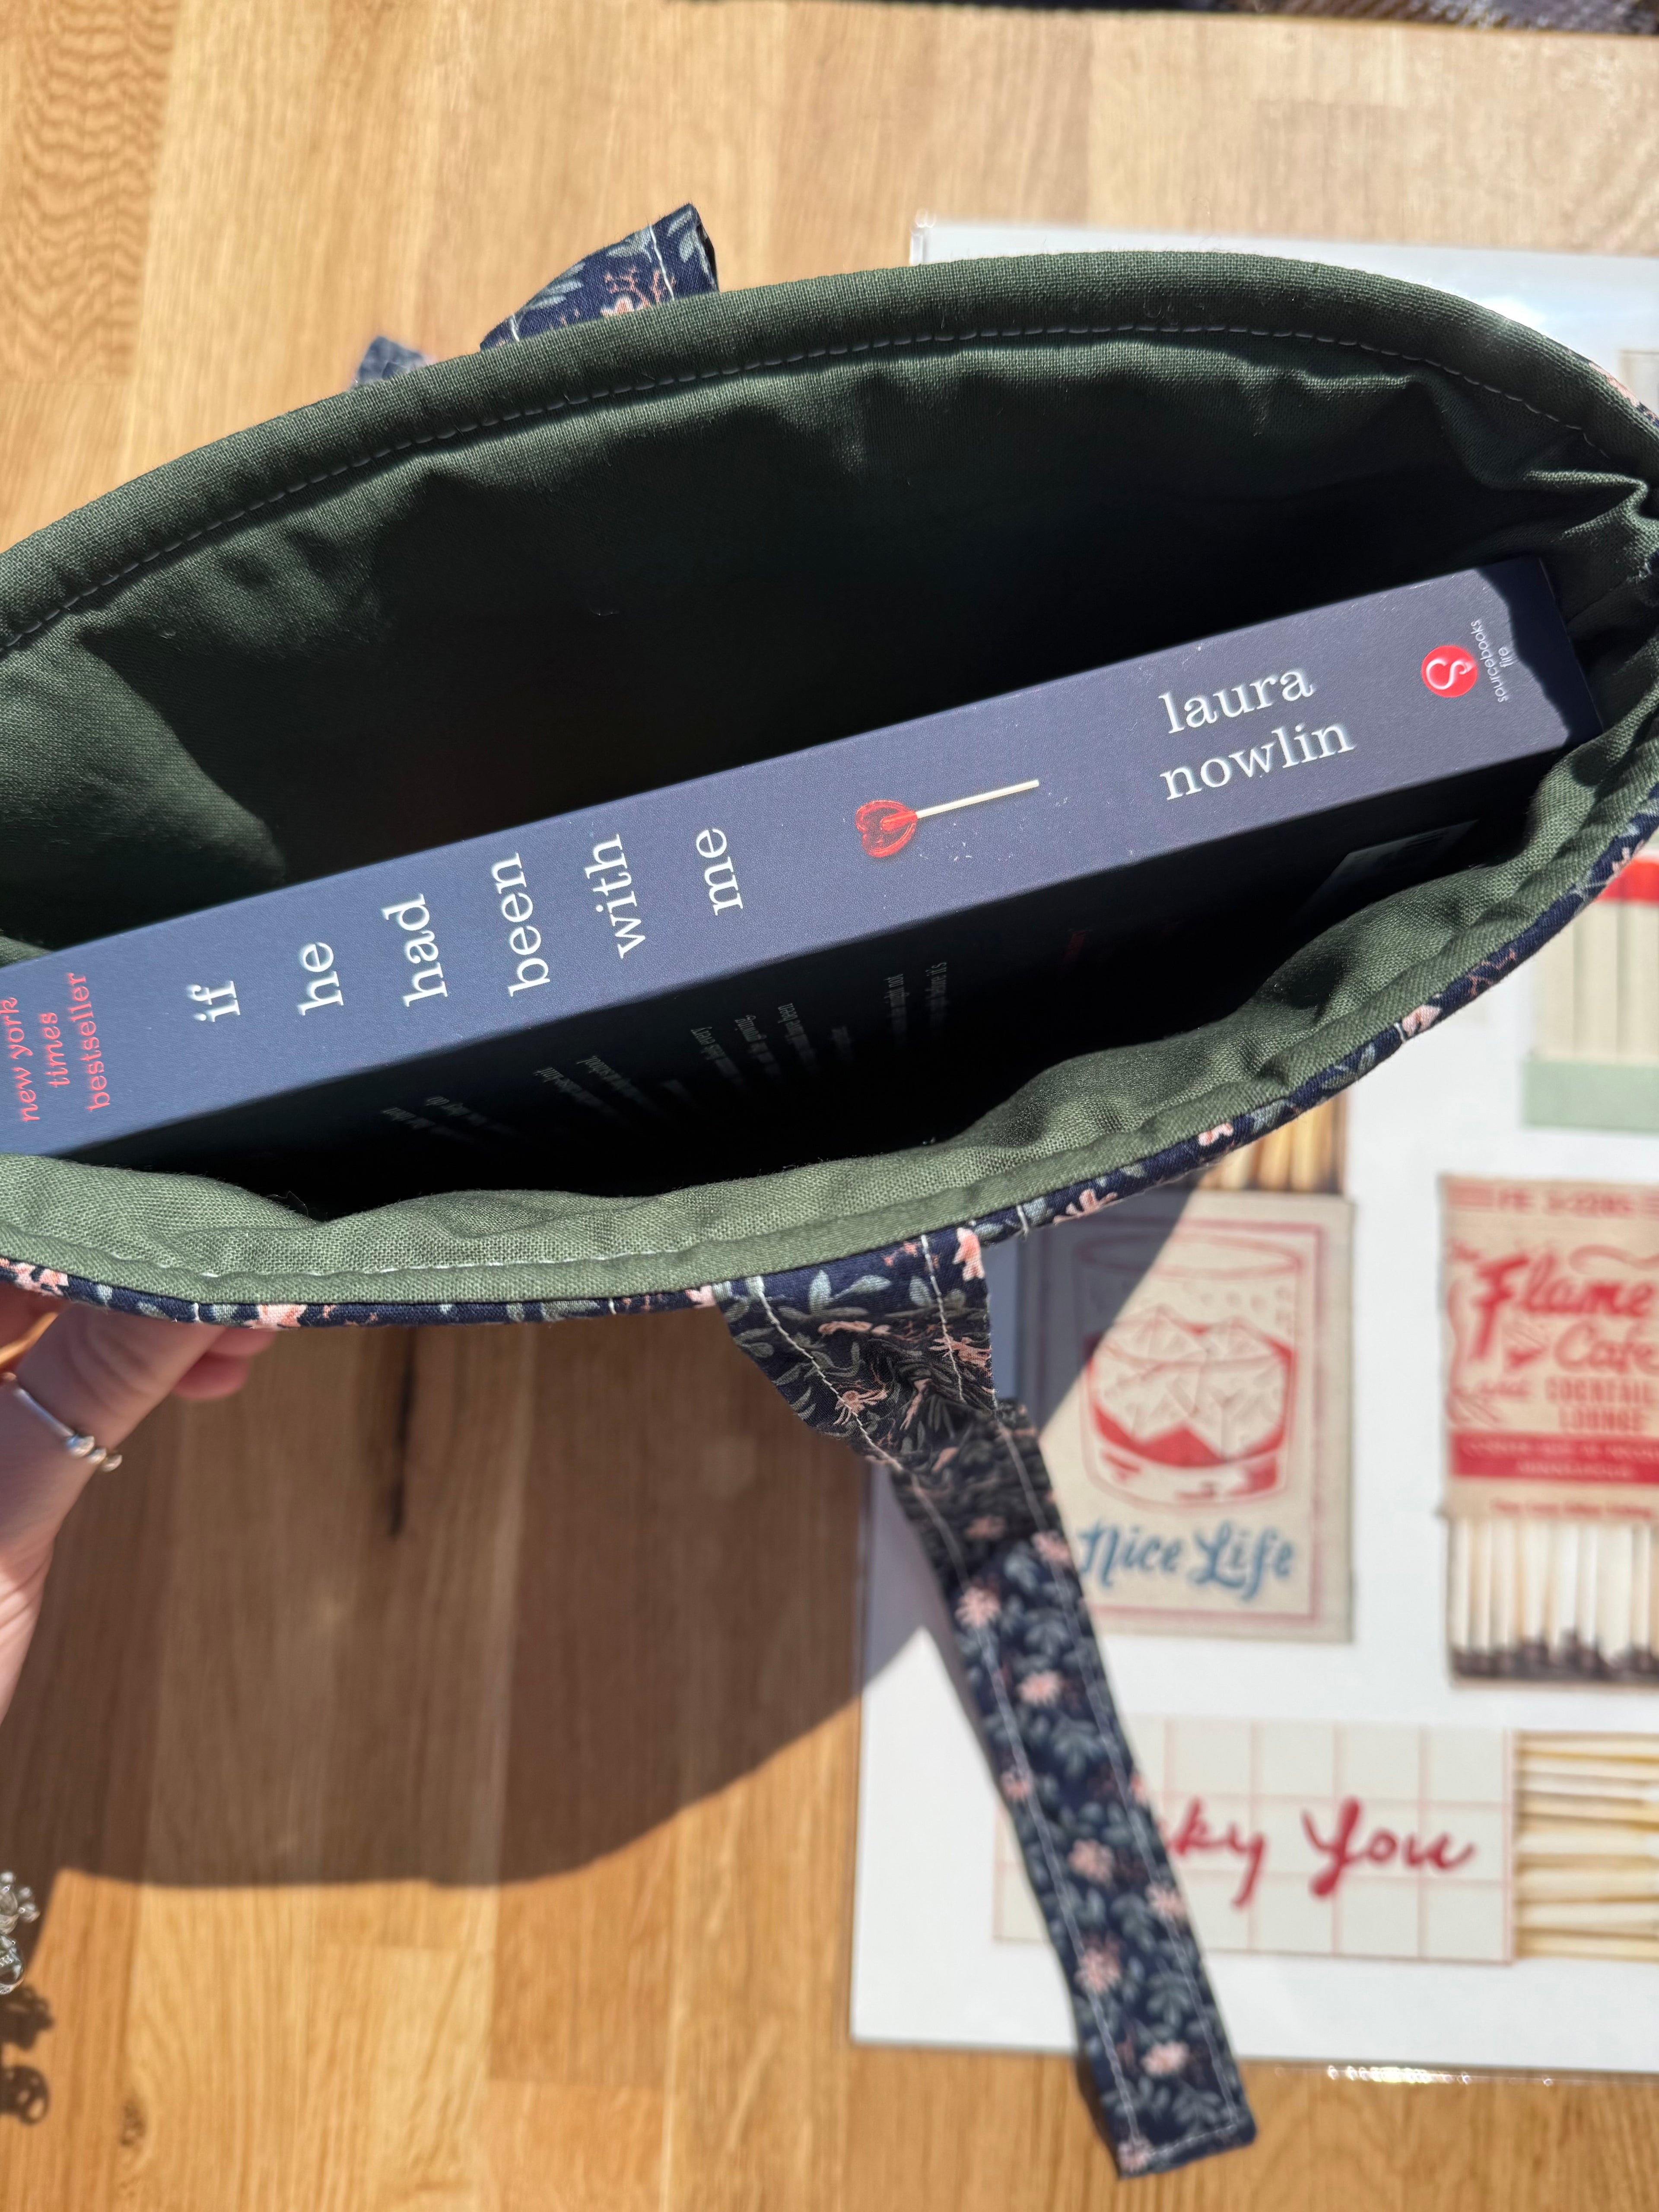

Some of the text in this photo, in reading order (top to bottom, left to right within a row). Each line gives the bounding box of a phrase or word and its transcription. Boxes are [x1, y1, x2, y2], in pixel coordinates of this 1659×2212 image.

[1470, 619, 1508, 703] sourcebooks
[1498, 646, 1515, 668] fire
[1158, 668, 1315, 734] laura
[1159, 723, 1356, 801] nowlin
[584, 834, 646, 959] with
[696, 828, 744, 916] me
[382, 893, 448, 1007] had
[491, 852, 550, 997] been
[188, 980, 241, 1023] if
[296, 941, 344, 1016] he
[777, 1002, 799, 1024] been
[884, 973, 904, 988] not
[0, 997, 40, 1122] new york
[39, 1012, 70, 1088] times
[67, 972, 110, 1112] bestseller
[690, 1027, 716, 1045] every
[1077, 1519, 1295, 1602] Nice Life
[1160, 1796, 1477, 1910] ky You
